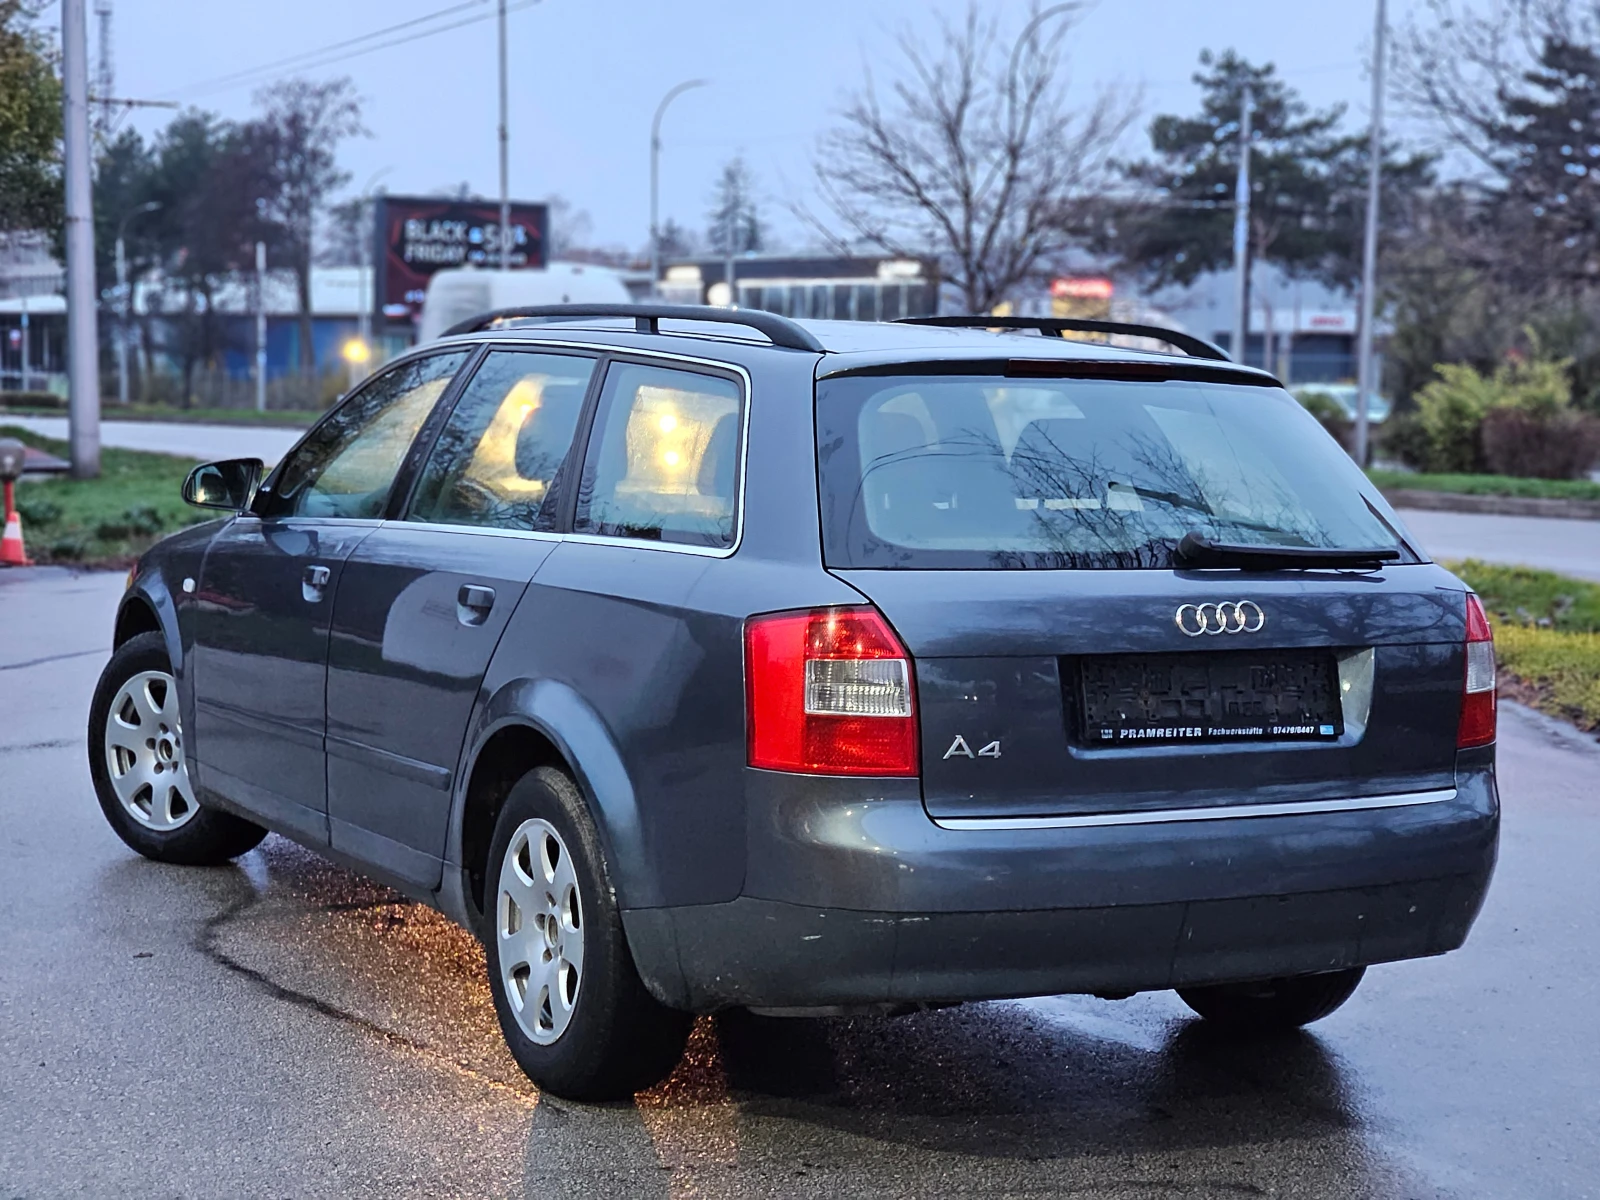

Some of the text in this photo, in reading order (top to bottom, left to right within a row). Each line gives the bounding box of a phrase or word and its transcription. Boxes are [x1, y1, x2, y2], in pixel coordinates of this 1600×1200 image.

[405, 219, 467, 241] BLACK
[404, 243, 466, 262] FRIDAY
[1120, 727, 1202, 739] PRAMREITER
[943, 735, 1002, 760] A4
